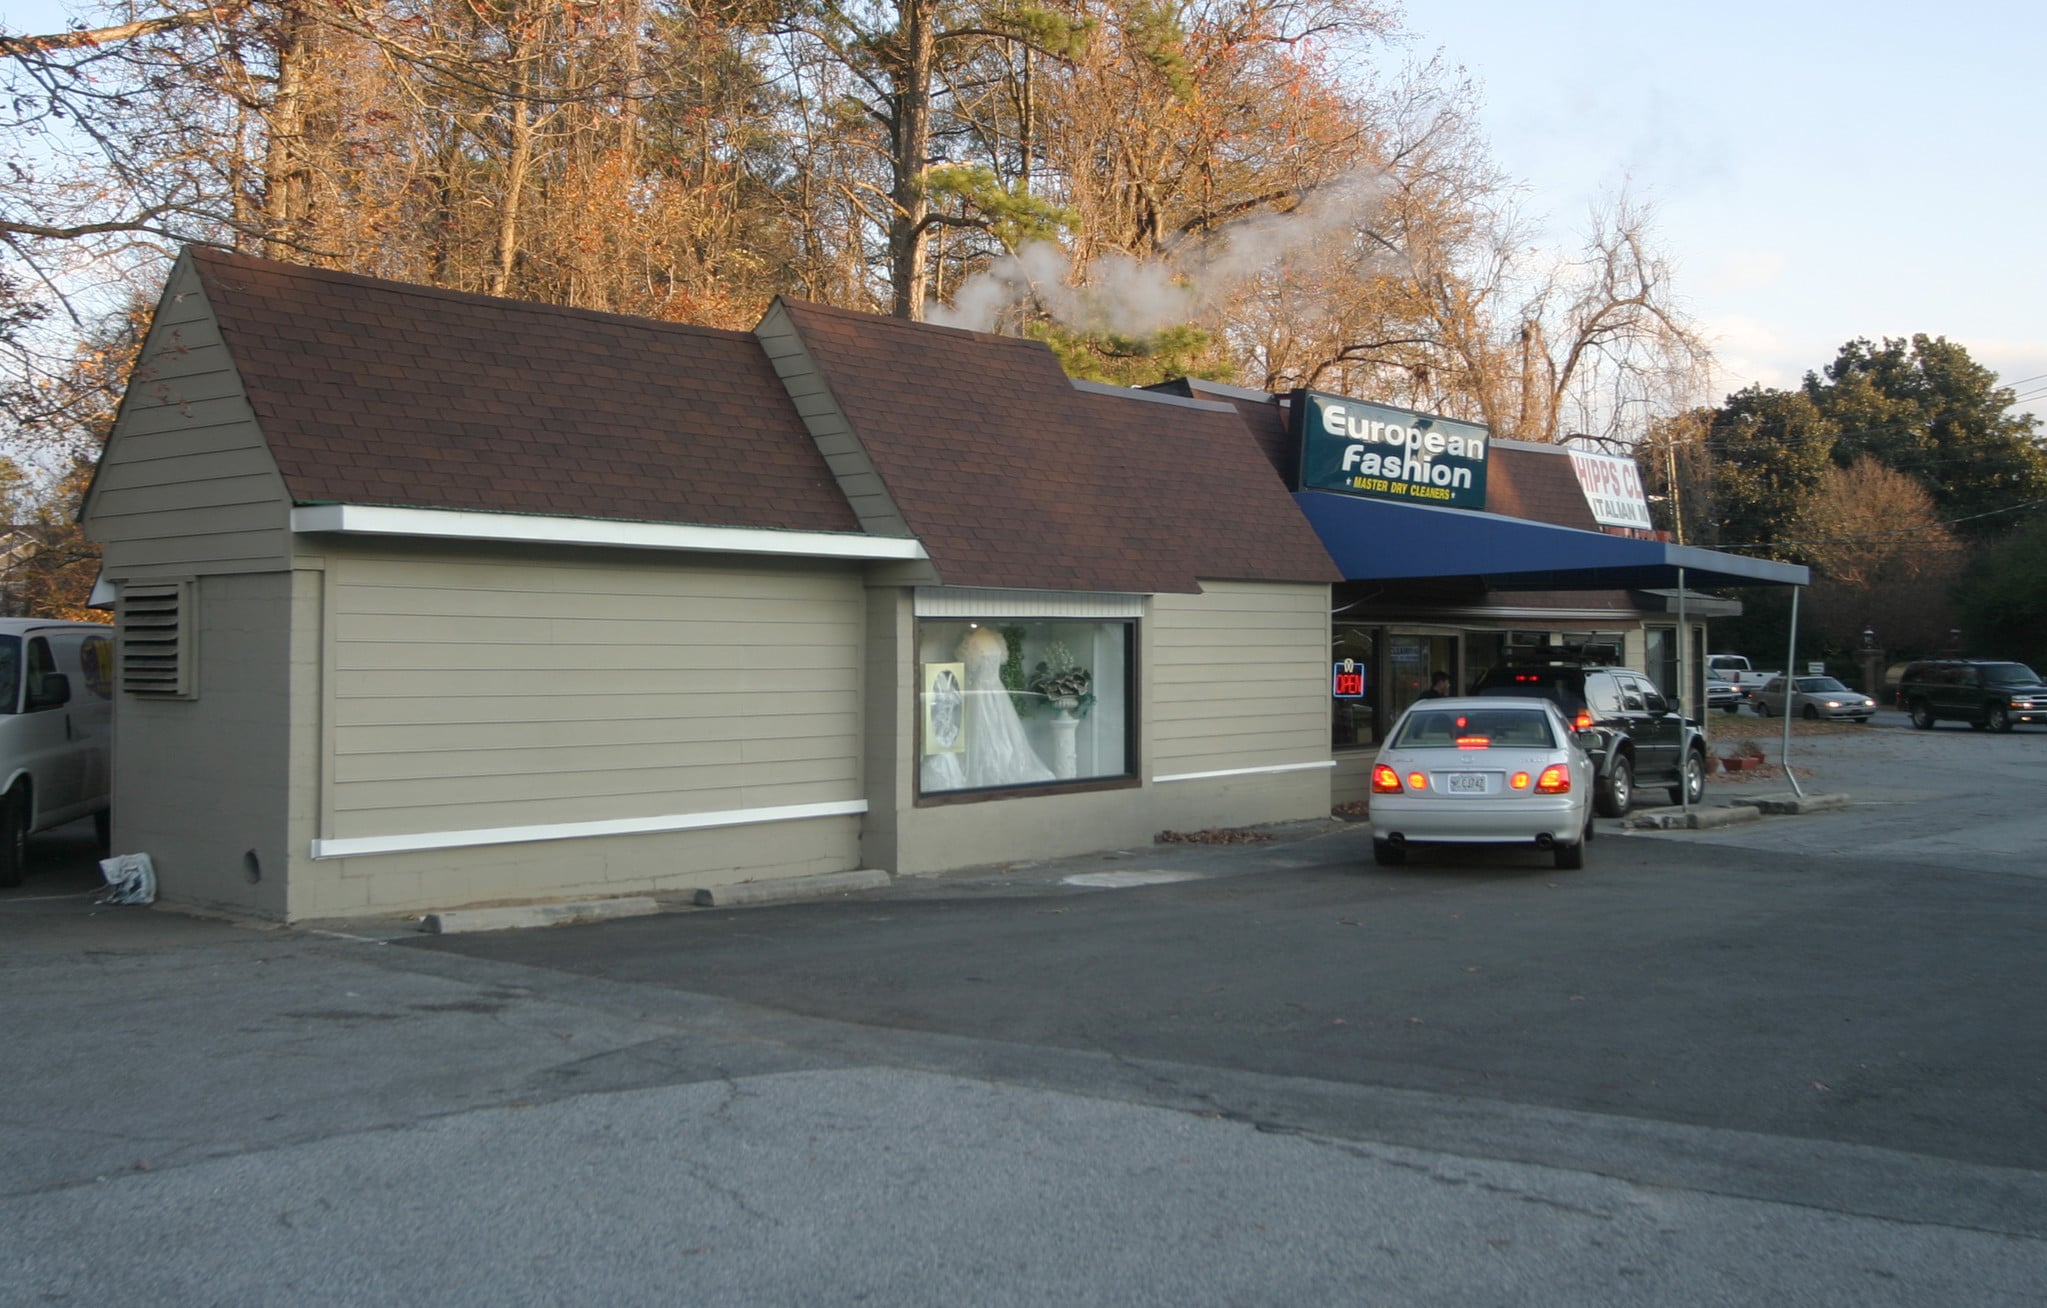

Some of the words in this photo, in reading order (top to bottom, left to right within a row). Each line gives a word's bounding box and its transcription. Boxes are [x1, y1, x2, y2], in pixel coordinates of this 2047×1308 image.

[1323, 405, 1484, 460] European
[1342, 444, 1472, 489] Fashion
[1353, 476, 1388, 492] MASTER
[1391, 481, 1407, 495] DRY
[1410, 484, 1450, 500] CLEANERS
[1592, 498, 1637, 521] ITALIAN
[1336, 674, 1362, 694] OPEN
